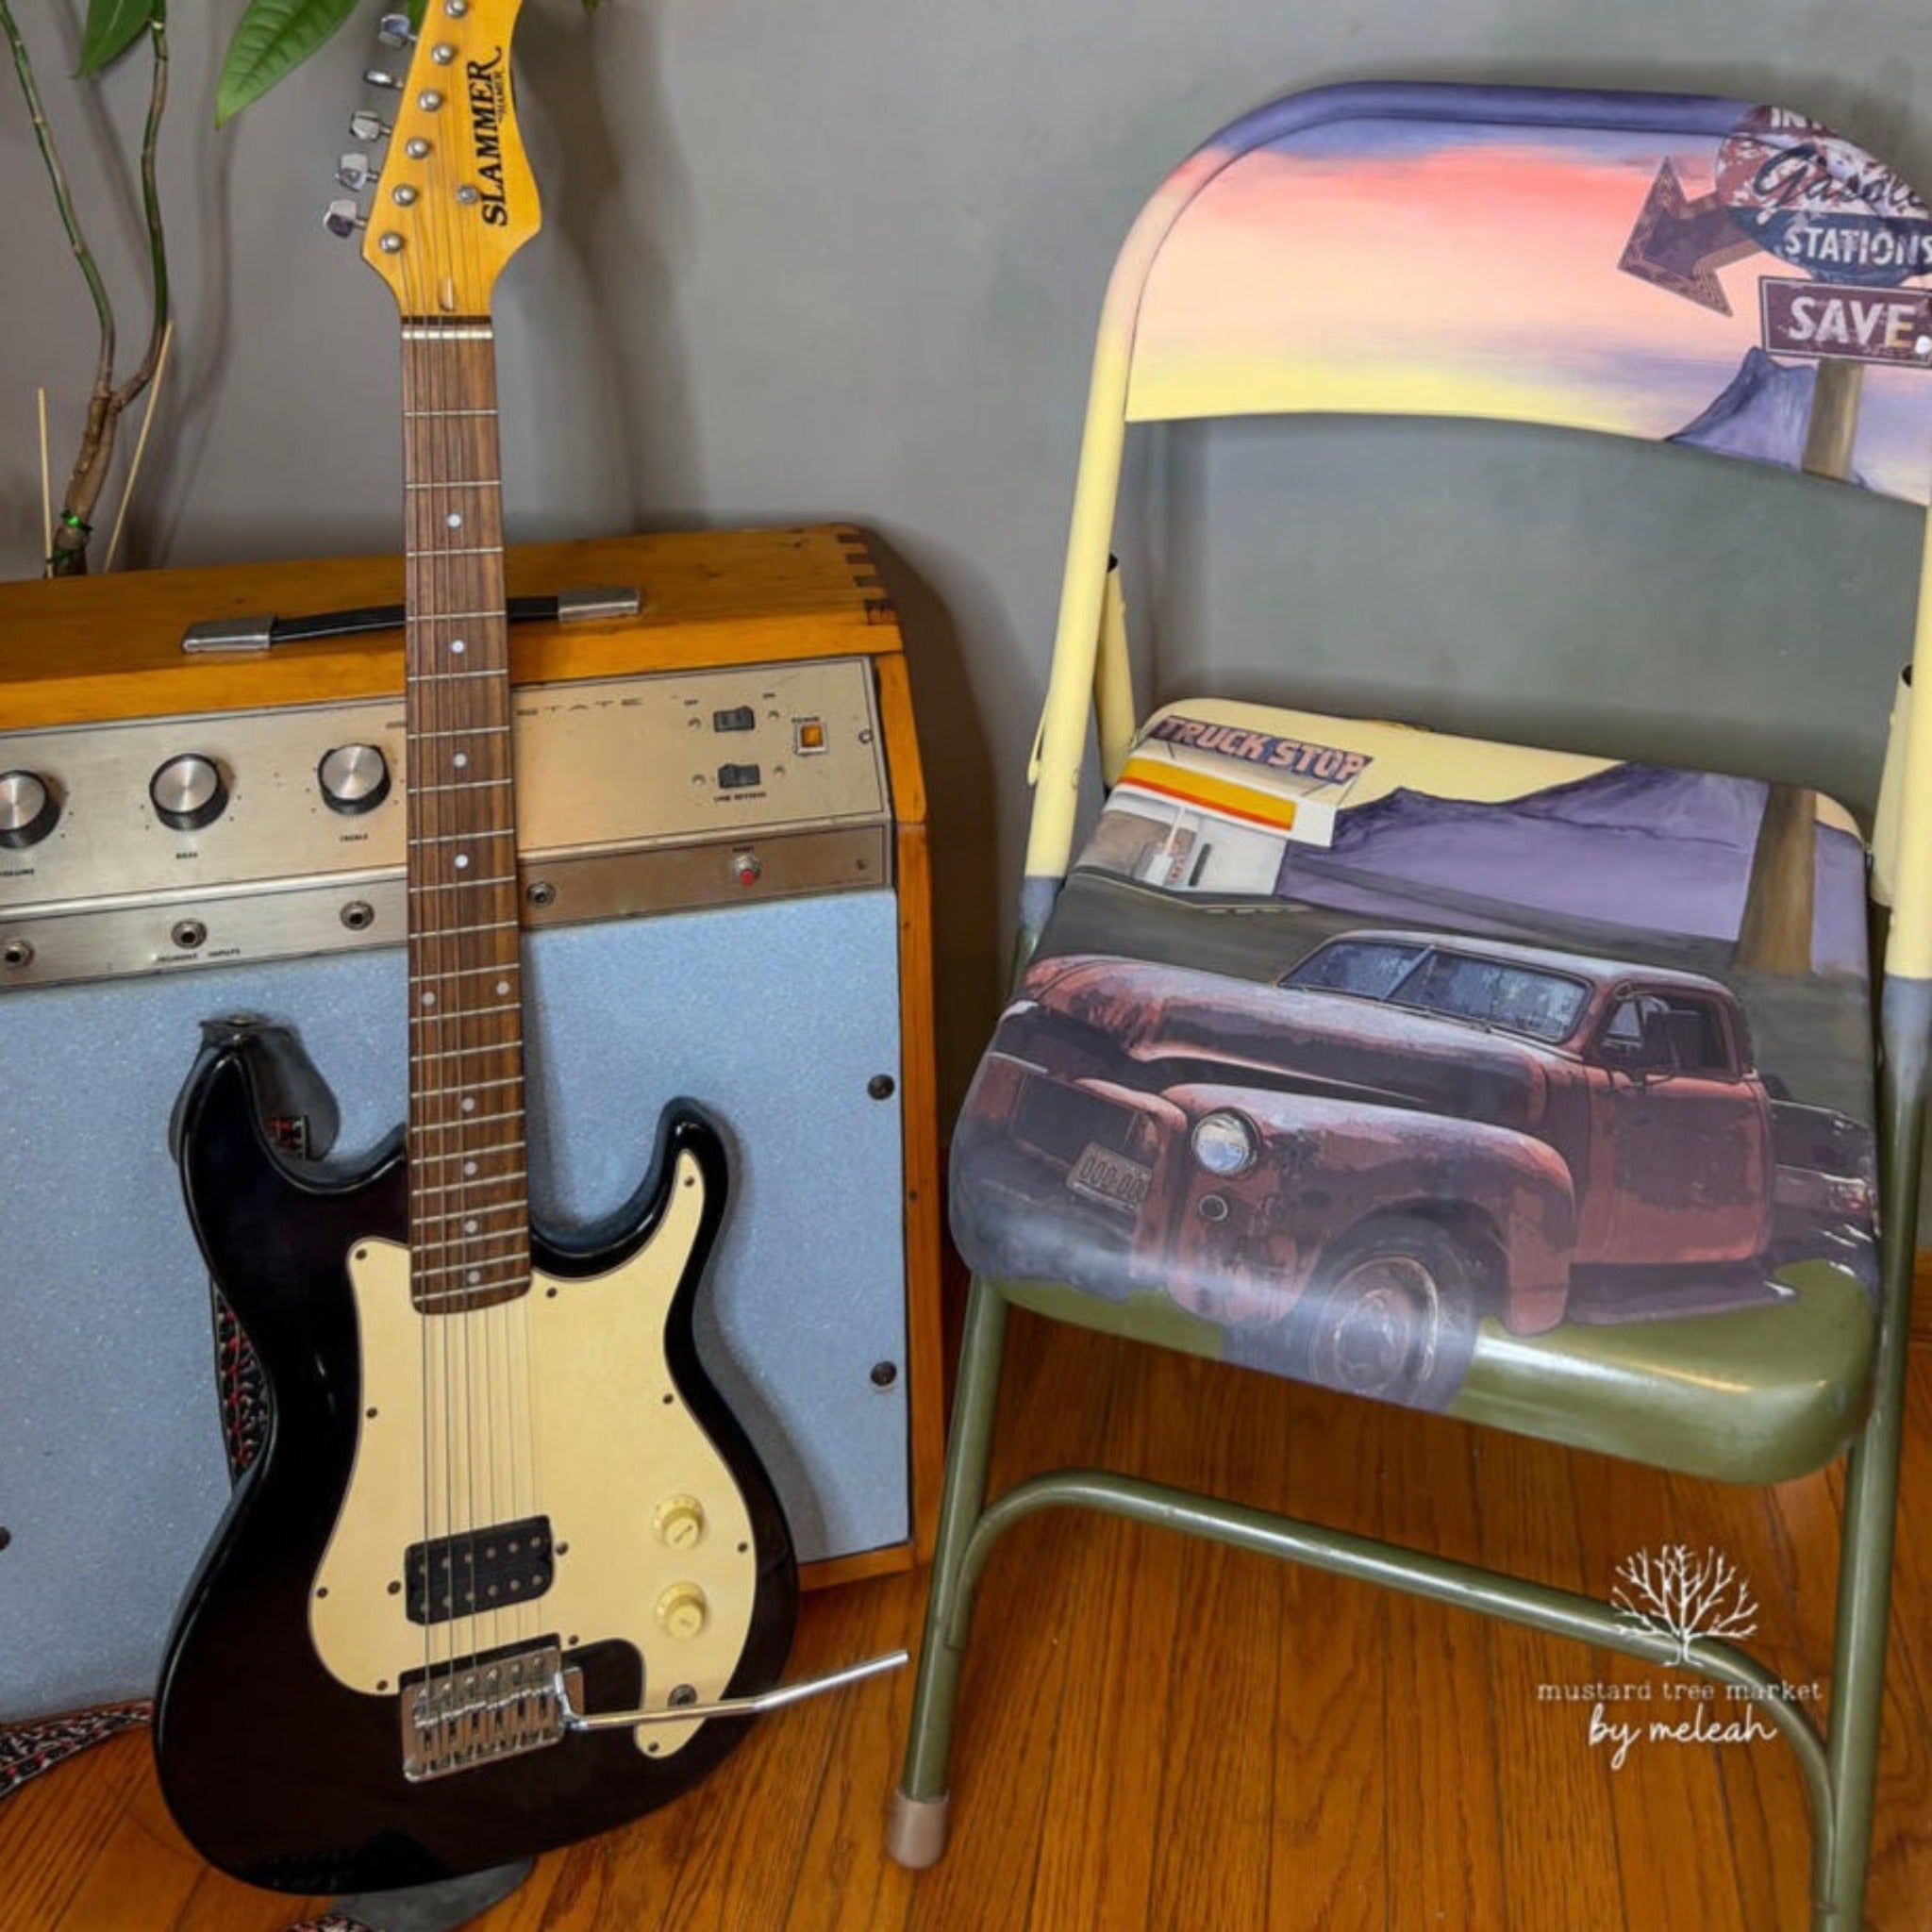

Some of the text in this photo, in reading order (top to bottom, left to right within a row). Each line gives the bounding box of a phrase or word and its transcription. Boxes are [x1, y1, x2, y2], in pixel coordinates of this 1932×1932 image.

[466, 45, 508, 226] SLAMMER
[1160, 719, 1366, 781] TRUCK STOP
